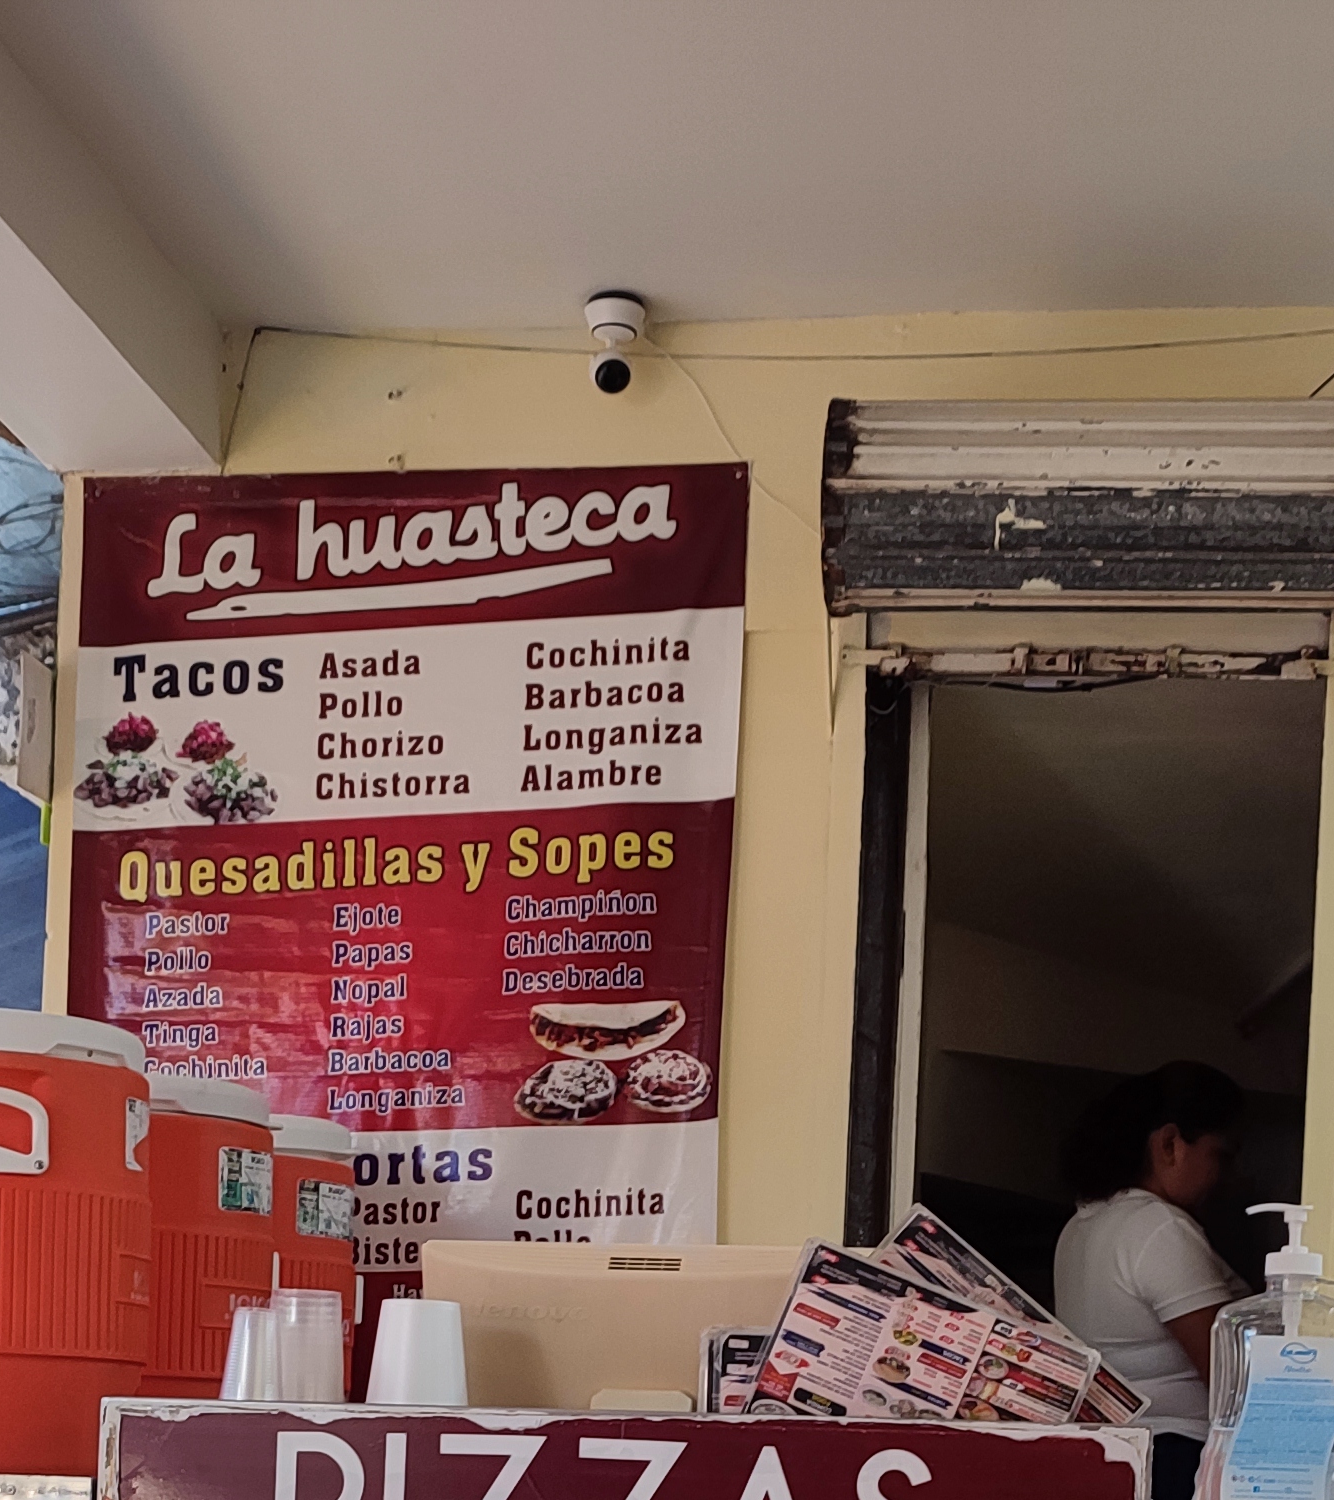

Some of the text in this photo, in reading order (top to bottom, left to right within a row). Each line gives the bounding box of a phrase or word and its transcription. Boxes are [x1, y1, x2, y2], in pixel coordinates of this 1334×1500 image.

[147, 482, 677, 598] La huasteca
[319, 650, 421, 679] Asada
[526, 637, 691, 670] Cochinita
[113, 654, 285, 702] Tacos
[318, 691, 404, 719] Pollo
[524, 680, 685, 711] Barbacoa
[317, 730, 445, 760] Chorizo
[523, 717, 703, 755] Longaniza
[315, 772, 471, 800] Chistorra
[520, 760, 662, 792] Alambre
[118, 827, 674, 902] Quesadillas y Sopes
[333, 903, 401, 935] Ejote
[506, 889, 657, 923] Champiñon
[145, 911, 230, 939] Pastor
[332, 940, 413, 970] Papas
[504, 927, 652, 959] Chicharron
[145, 946, 212, 976] Pollo
[142, 980, 223, 1010] Azada
[331, 973, 407, 1006] Nopal
[502, 962, 644, 996] Desebrada
[142, 1021, 219, 1049] Tinga
[330, 1012, 405, 1042] Rajas
[328, 1047, 452, 1075] Barbacoa
[327, 1083, 465, 1115] Longaniza
[353, 1144, 493, 1187] ortas
[516, 1188, 665, 1220] Cochinita
